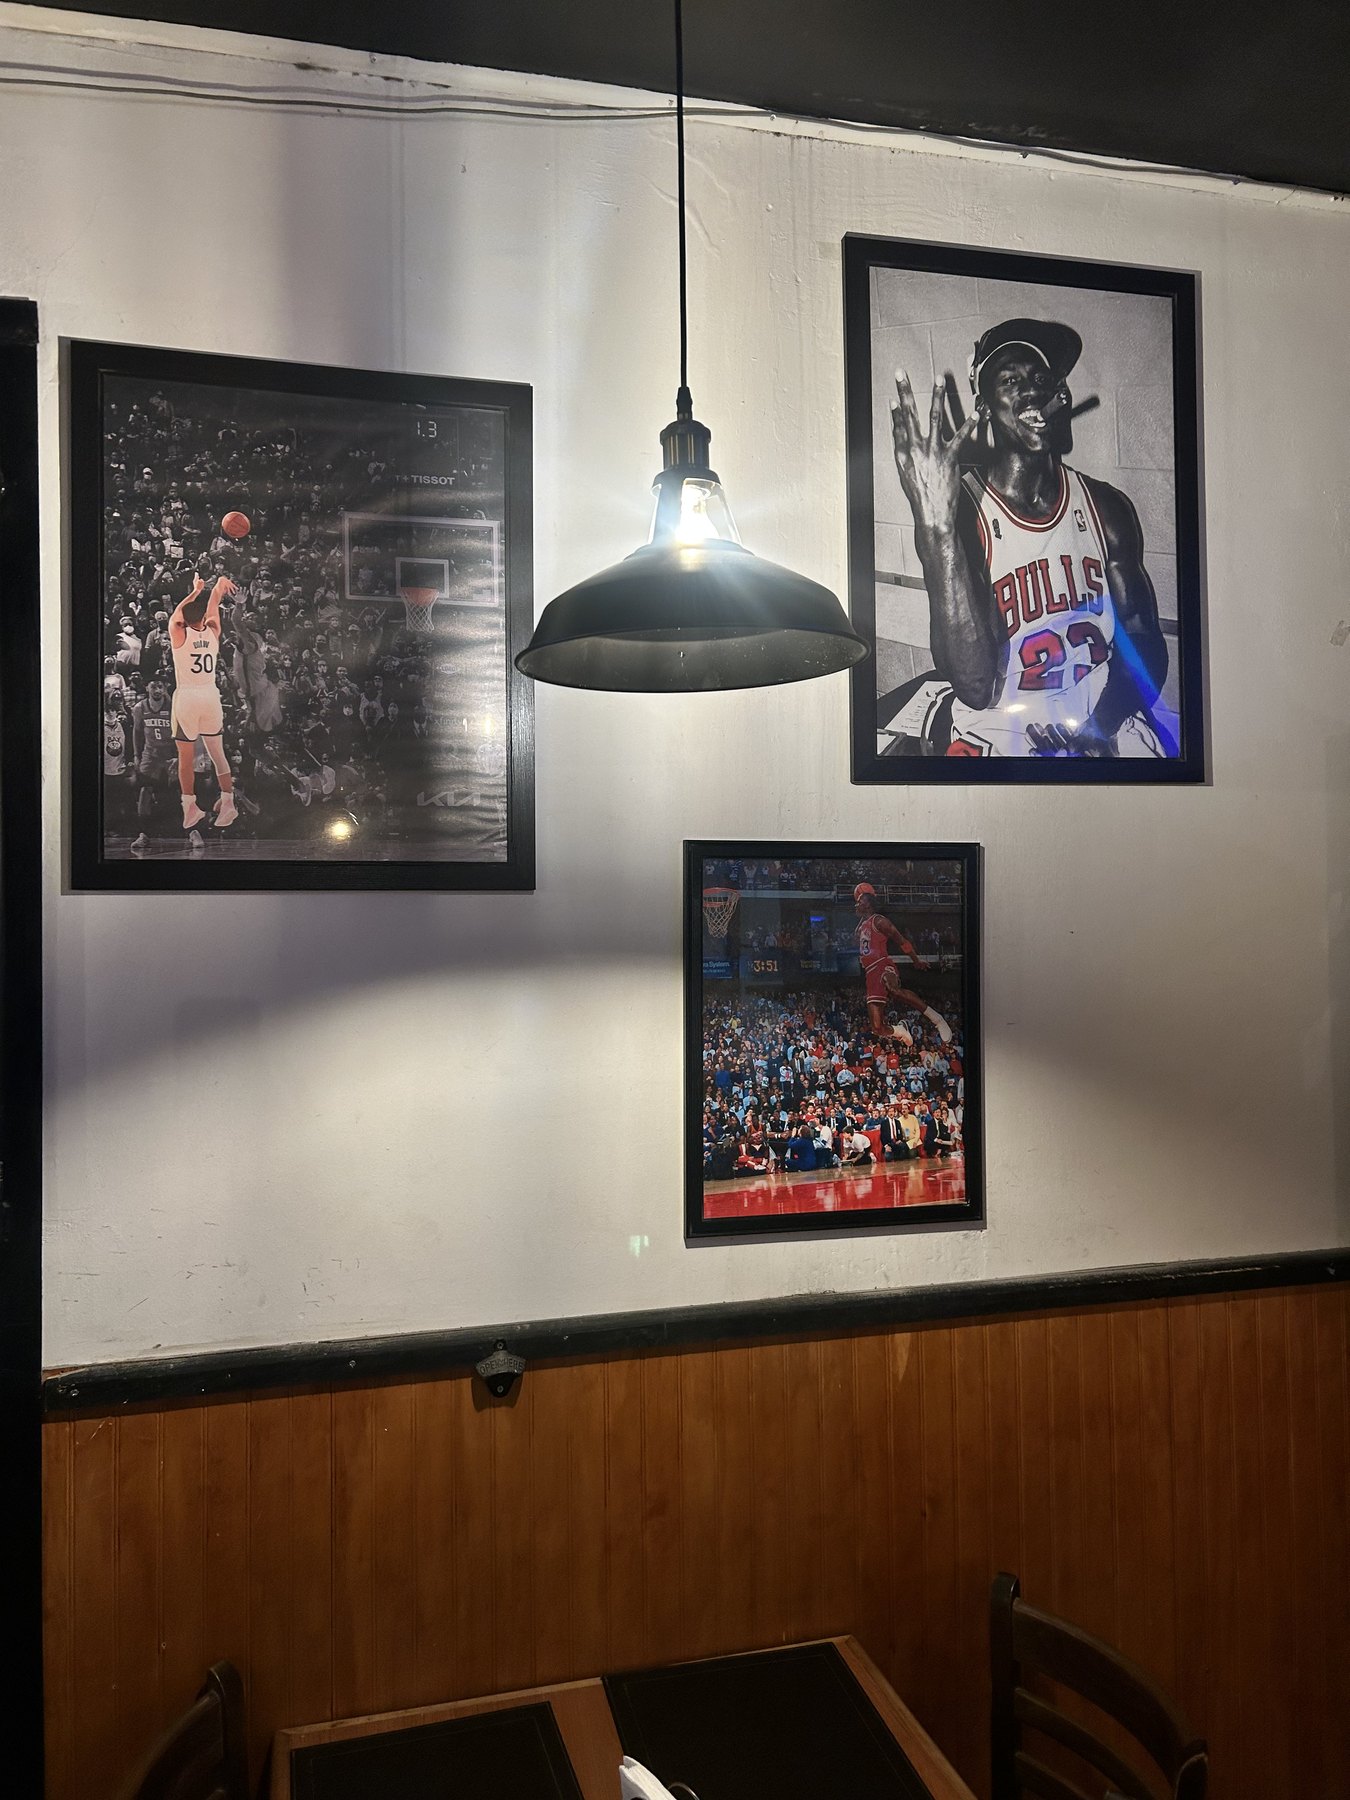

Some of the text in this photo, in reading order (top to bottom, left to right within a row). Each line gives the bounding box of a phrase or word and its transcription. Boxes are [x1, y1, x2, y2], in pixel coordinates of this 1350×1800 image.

[417, 421, 437, 438] 1.3
[411, 475, 455, 485] TISSOT
[992, 555, 1104, 639] BULLS
[190, 653, 213, 674] 30
[1018, 621, 1108, 691] 23
[154, 728, 162, 740] 6
[417, 791, 481, 807] KIA
[753, 960, 778, 972] 3:51
[480, 1357, 524, 1375] OPEN HERE
